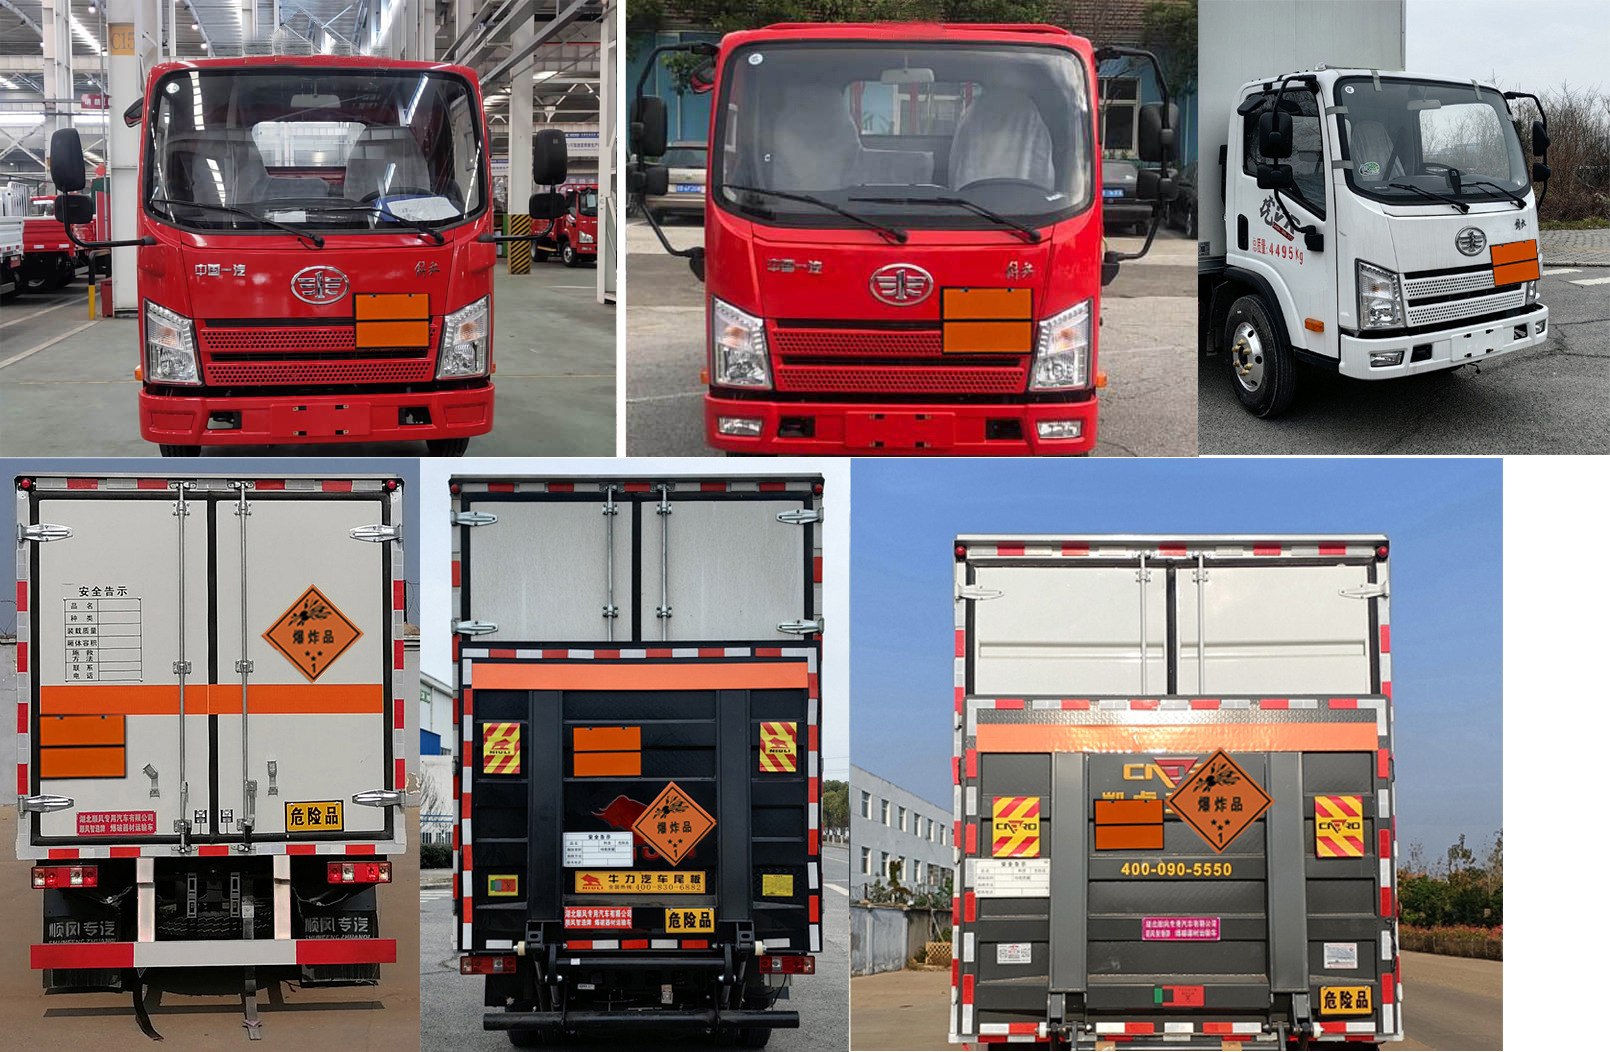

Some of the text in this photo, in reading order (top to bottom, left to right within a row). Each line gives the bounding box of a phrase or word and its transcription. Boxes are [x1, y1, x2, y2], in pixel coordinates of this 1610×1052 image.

[194, 263, 246, 277] 中国一汽
[79, 586, 128, 597] 安全告示
[292, 629, 335, 645] 爆炸品
[311, 662, 316, 674] 1
[1198, 796, 1243, 812] 爆炸品
[80, 813, 154, 823] 湖北顺风专用汽车有限公司
[290, 806, 339, 826] 危险品
[657, 821, 692, 834] 爆炸品
[1217, 833, 1224, 843] 1
[673, 849, 677, 858] 1
[1120, 862, 1233, 877] 400-090-5550
[608, 874, 702, 884] 牛力汽车尾板
[304, 916, 368, 933] 顺风专汽
[668, 911, 712, 929] 危险品
[48, 920, 115, 938] 顺风专汽
[1324, 990, 1369, 1010] 危险品
